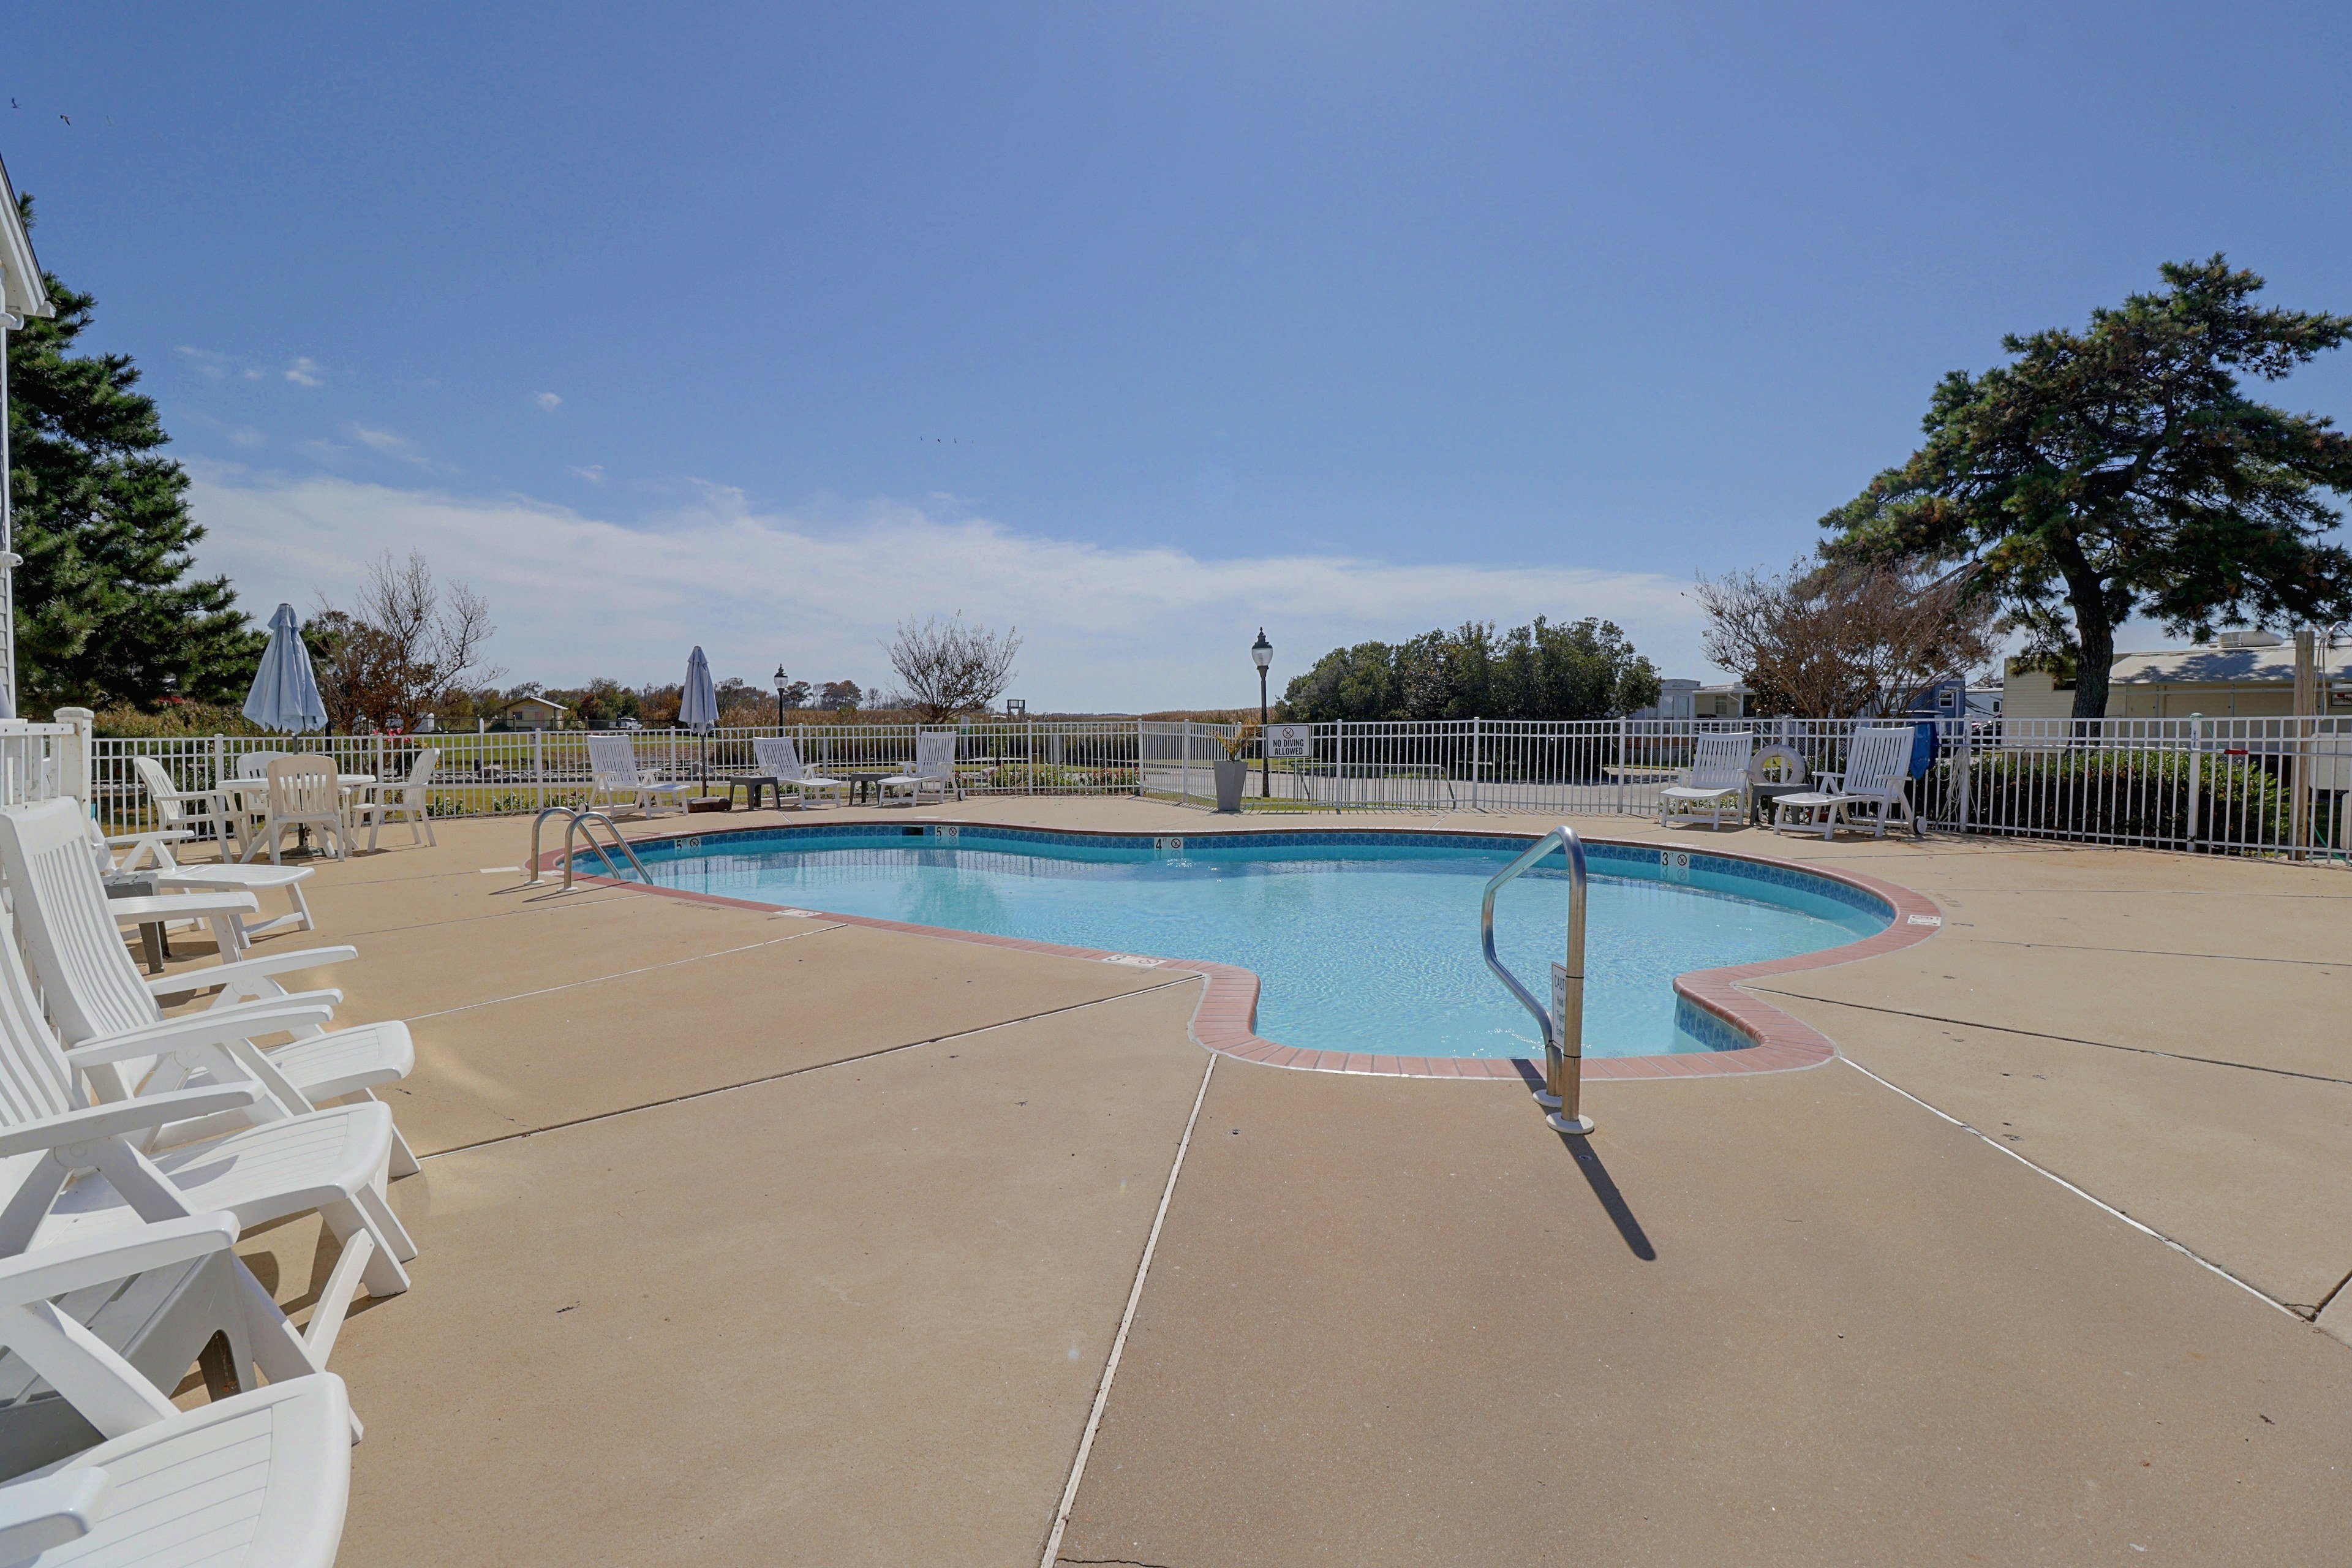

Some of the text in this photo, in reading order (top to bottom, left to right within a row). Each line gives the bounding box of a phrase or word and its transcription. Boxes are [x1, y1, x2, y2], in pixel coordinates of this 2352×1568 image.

[936, 826, 942, 837] 5
[676, 840, 682, 849] 5
[1156, 838, 1162, 850] 4
[1662, 852, 1668, 865] 3
